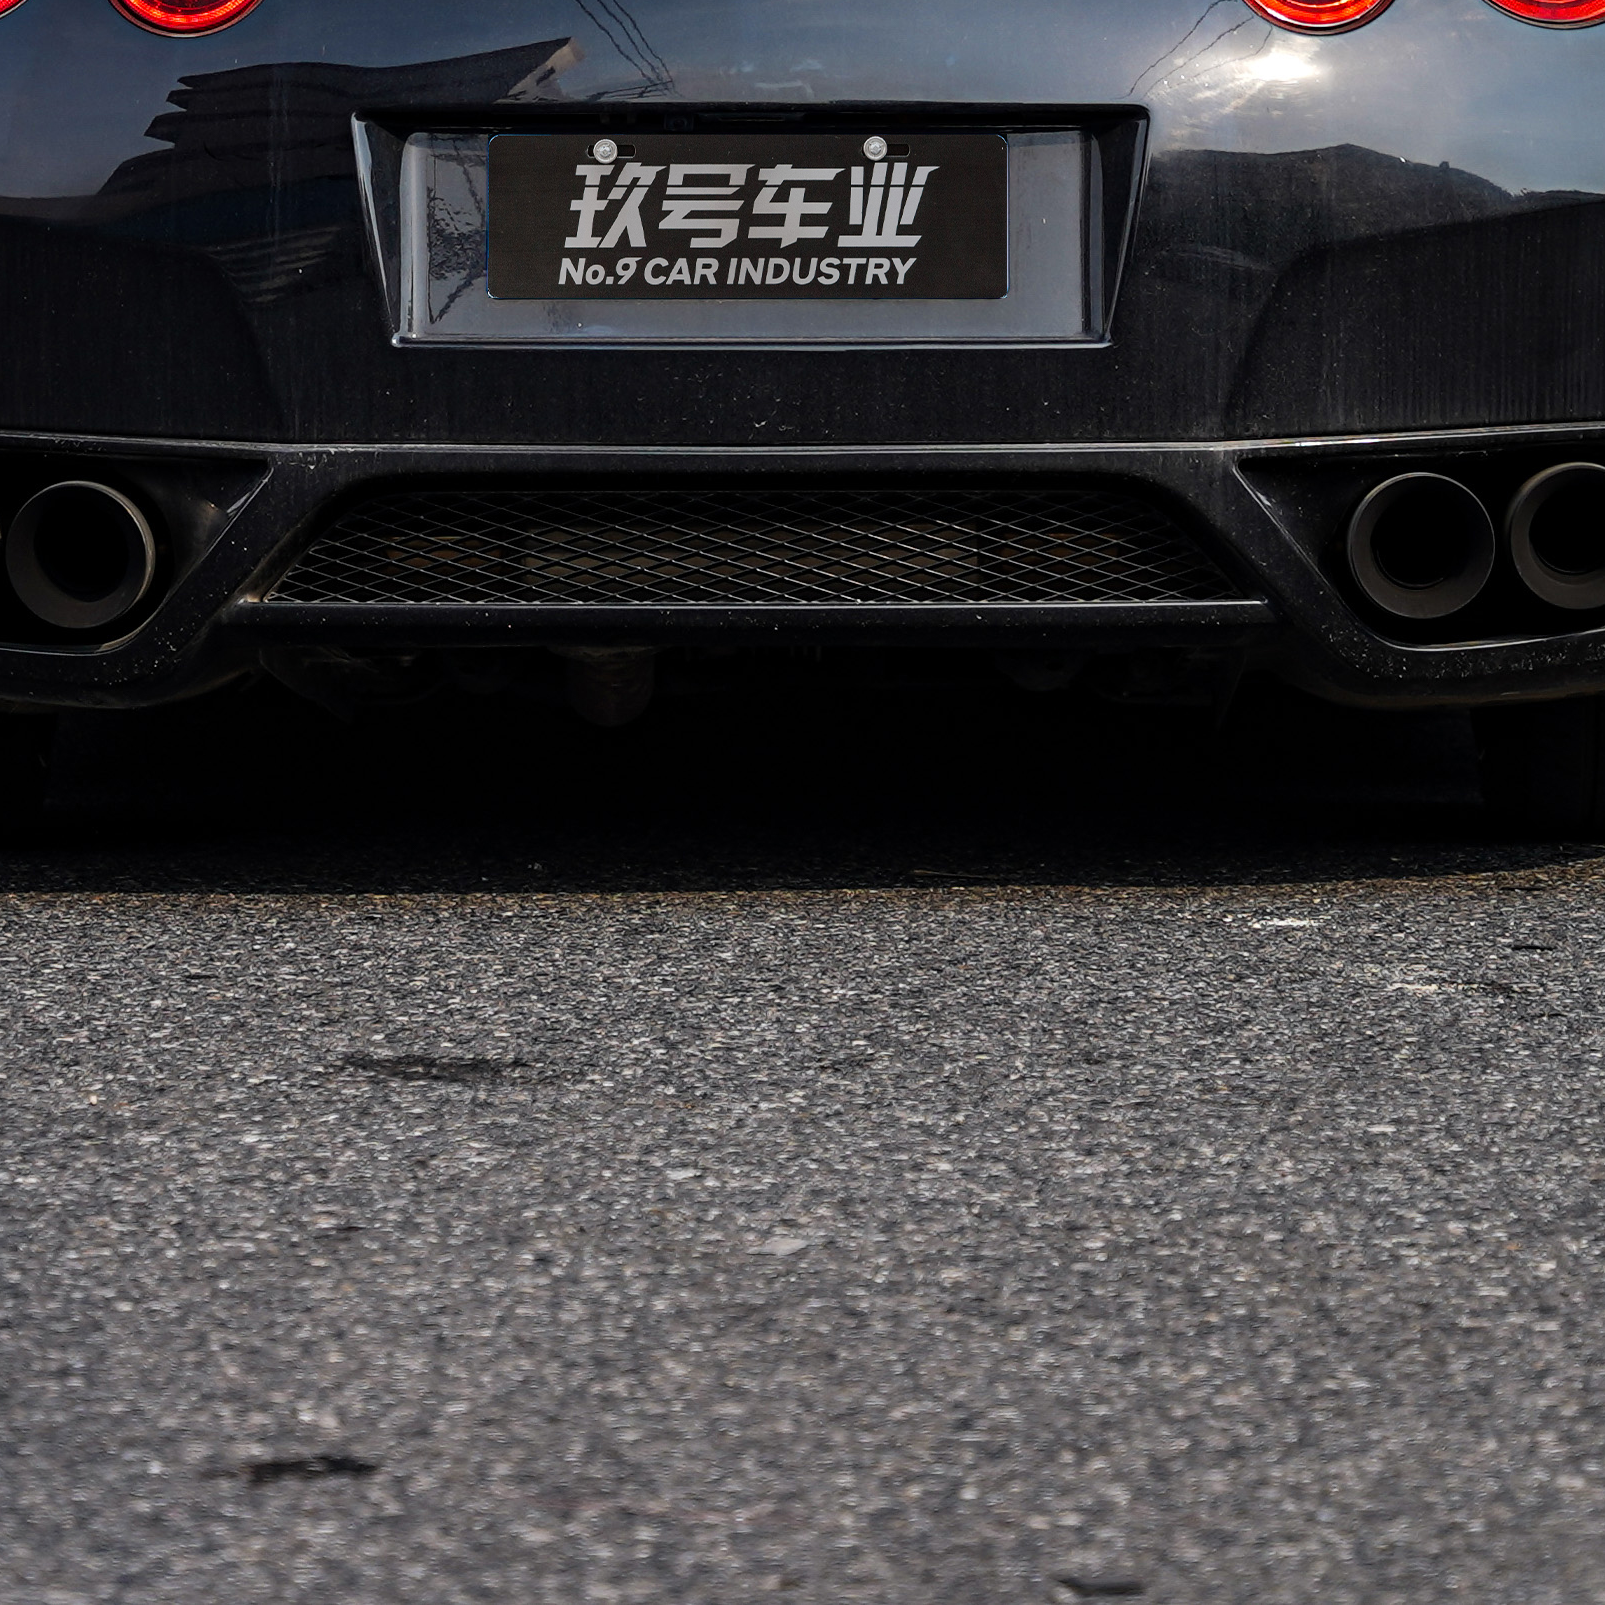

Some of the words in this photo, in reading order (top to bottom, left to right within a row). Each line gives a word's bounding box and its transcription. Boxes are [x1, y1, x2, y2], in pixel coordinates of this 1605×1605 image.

[564, 161, 940, 249] 玖号车业
[557, 257, 643, 286] No.9
[643, 257, 719, 286] CAR
[726, 257, 918, 286] INDUSTRY
